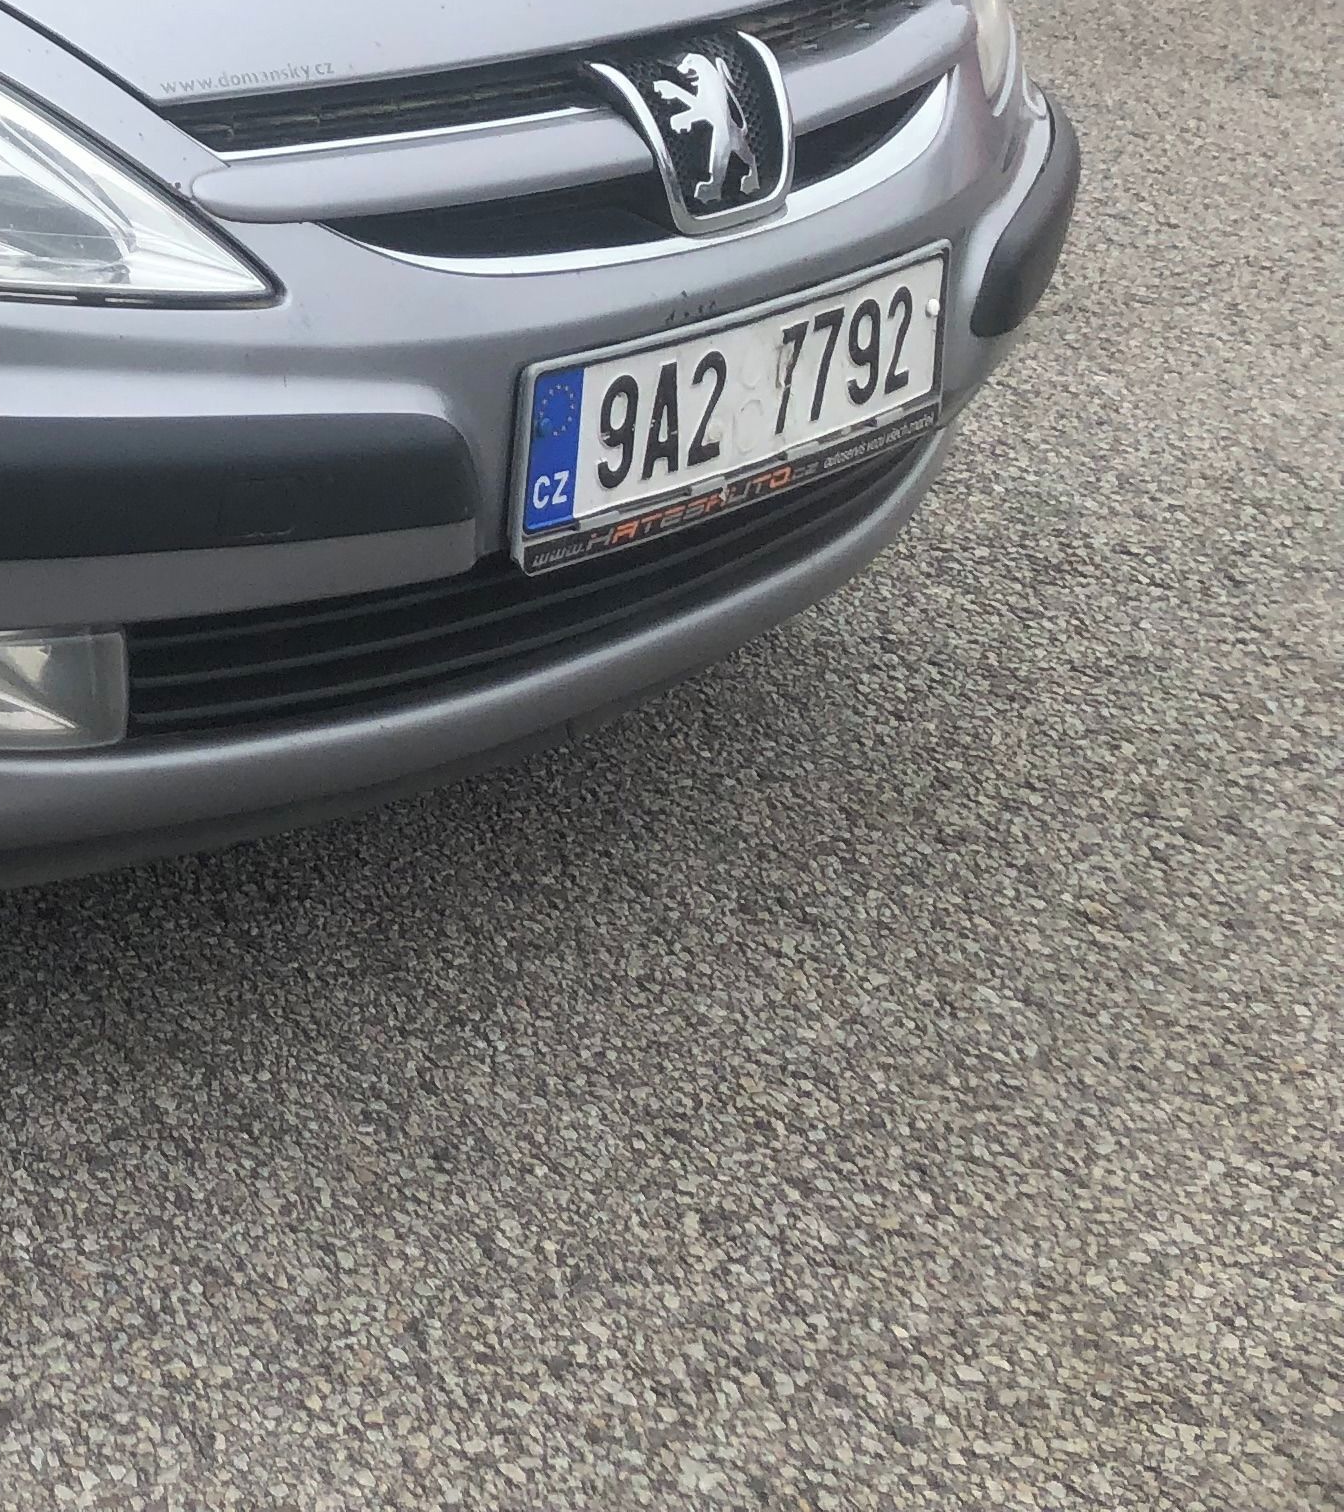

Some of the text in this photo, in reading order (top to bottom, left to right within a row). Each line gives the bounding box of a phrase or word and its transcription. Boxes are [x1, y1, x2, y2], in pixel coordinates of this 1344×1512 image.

[597, 285, 914, 489] 9A2 7792
[533, 471, 569, 509] CZ
